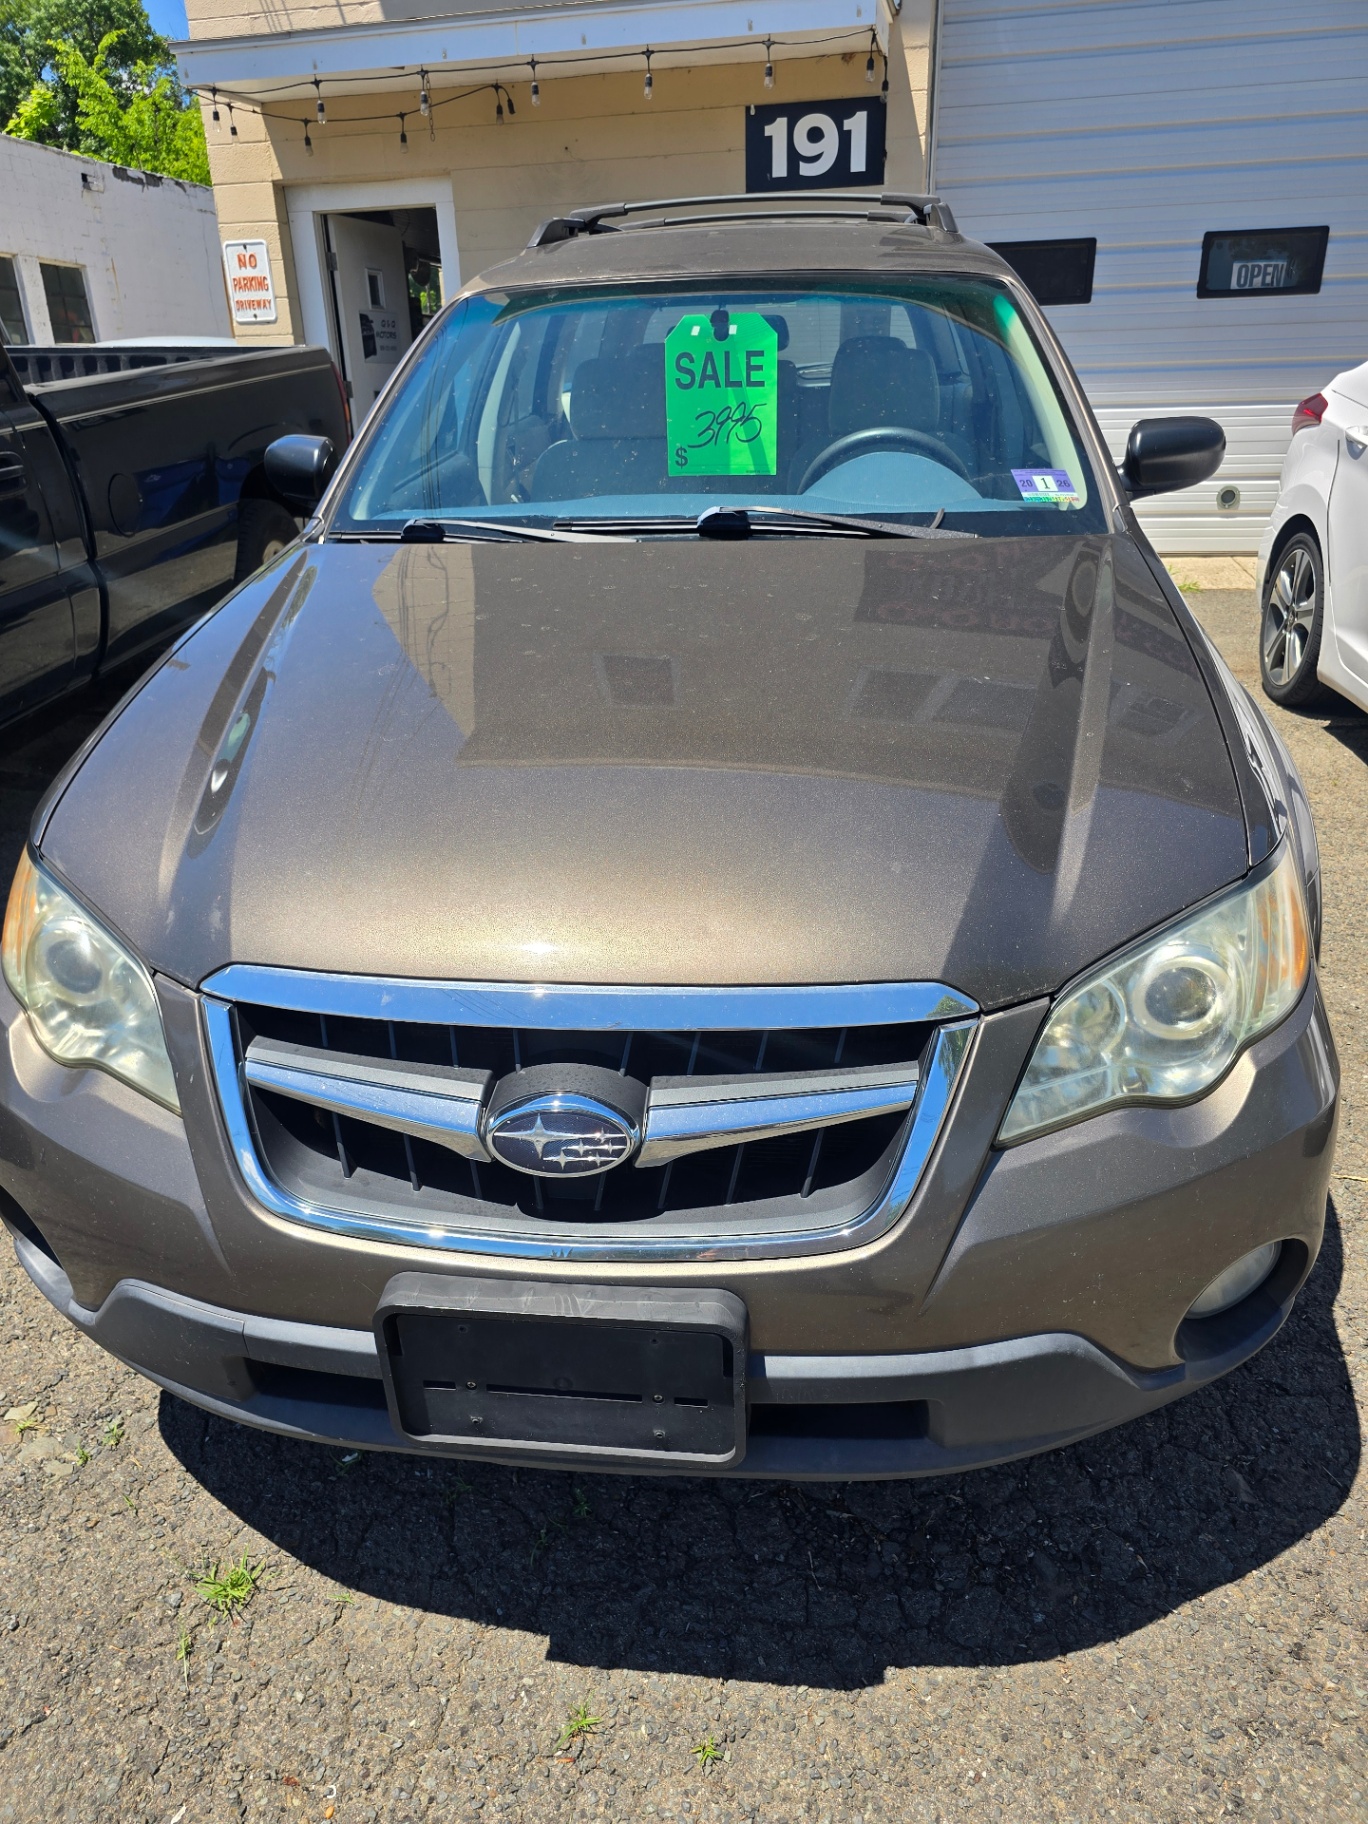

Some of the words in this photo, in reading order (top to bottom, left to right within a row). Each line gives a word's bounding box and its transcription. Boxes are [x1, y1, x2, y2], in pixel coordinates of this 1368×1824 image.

[764, 110, 868, 178] 191
[237, 253, 257, 270] NO
[232, 275, 269, 293] PARKING
[1236, 263, 1285, 288] OPEN
[235, 298, 272, 312] DRIVEWAY
[675, 350, 766, 390] SALE
[675, 446, 688, 469] $
[687, 401, 767, 449] 3995
[1019, 479, 1033, 488] 20
[1041, 477, 1050, 490] 1
[1056, 479, 1071, 488] 26
